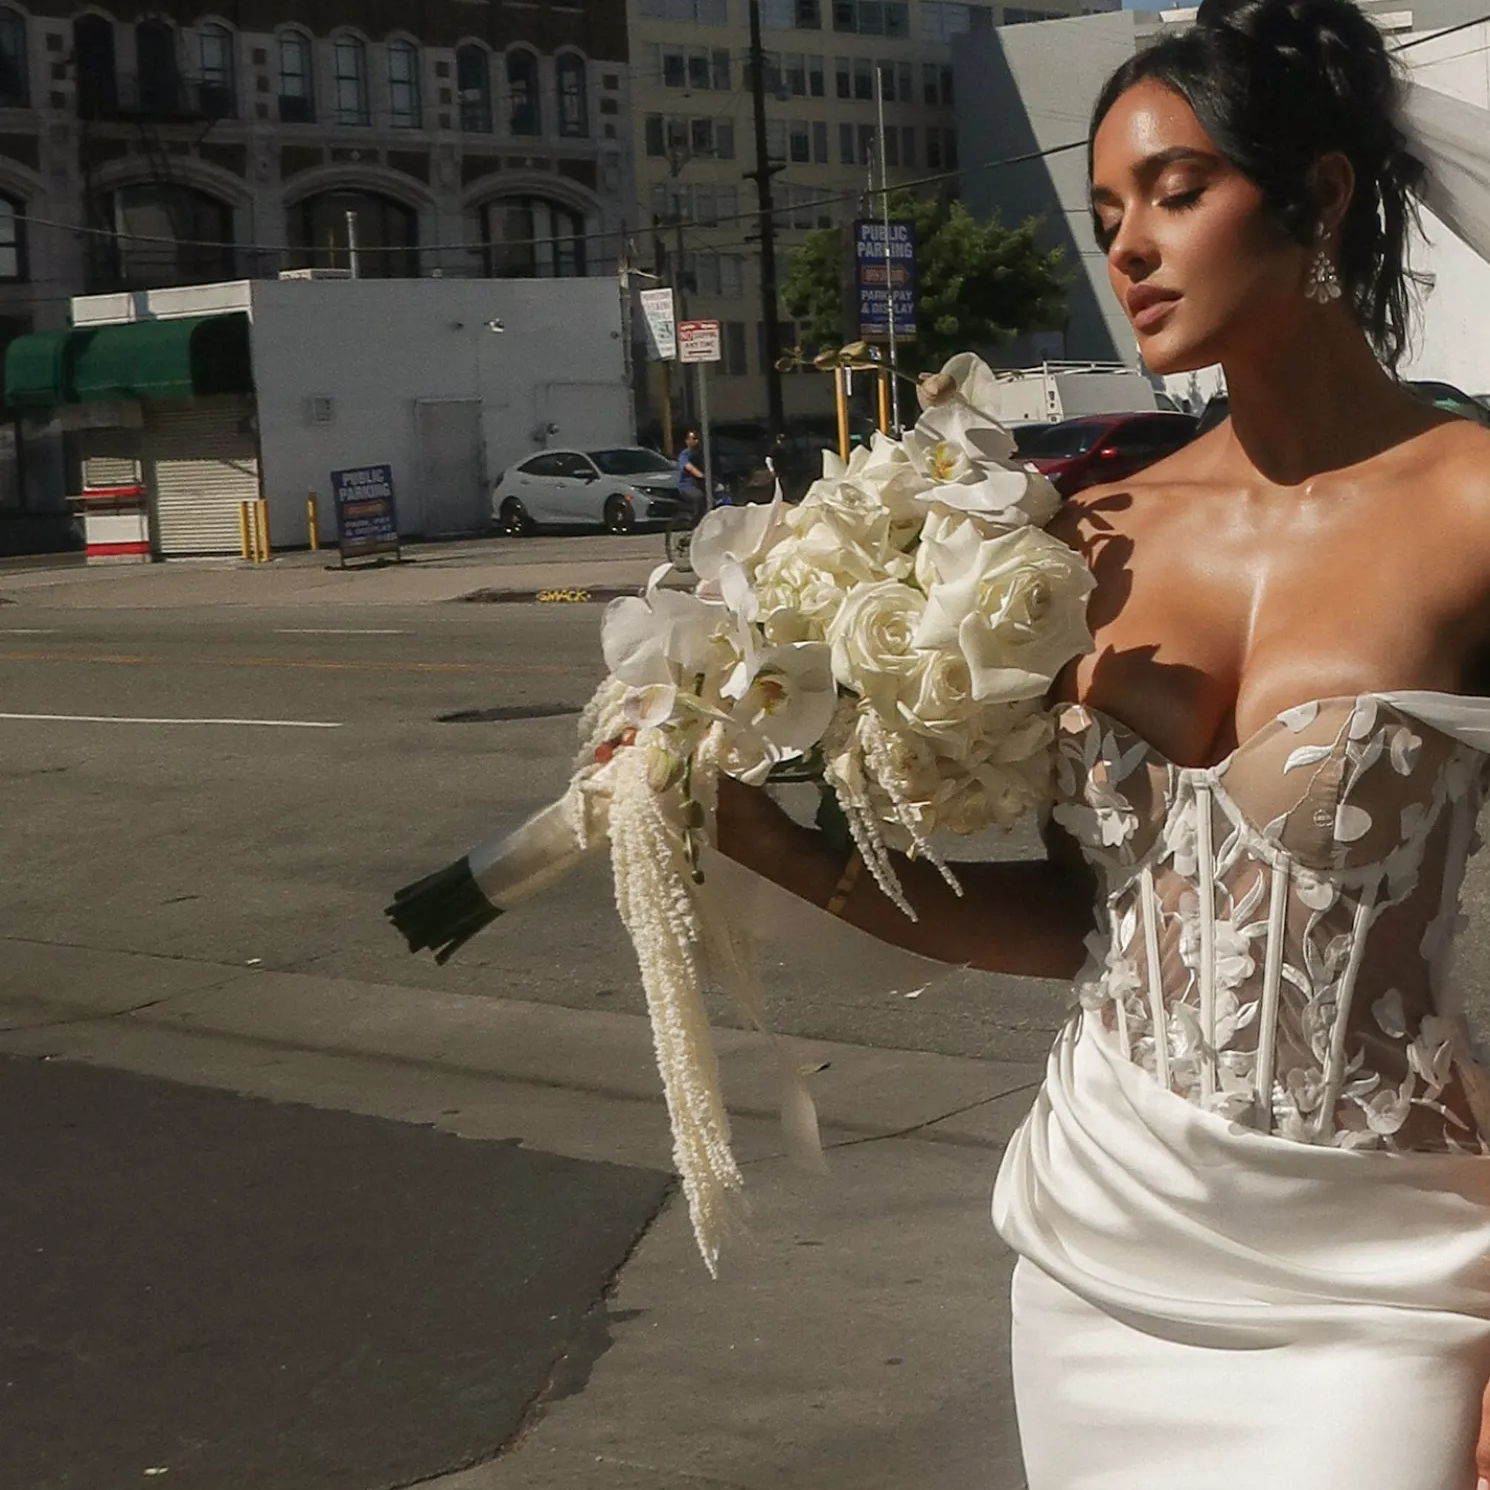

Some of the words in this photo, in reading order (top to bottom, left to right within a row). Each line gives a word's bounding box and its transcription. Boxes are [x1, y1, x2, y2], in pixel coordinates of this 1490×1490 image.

[862, 225, 907, 241] PUBLIC
[893, 290, 913, 300] PAY
[871, 302, 914, 314] DISLAY
[342, 468, 385, 487] PUBLIC
[339, 482, 392, 502] PARKING
